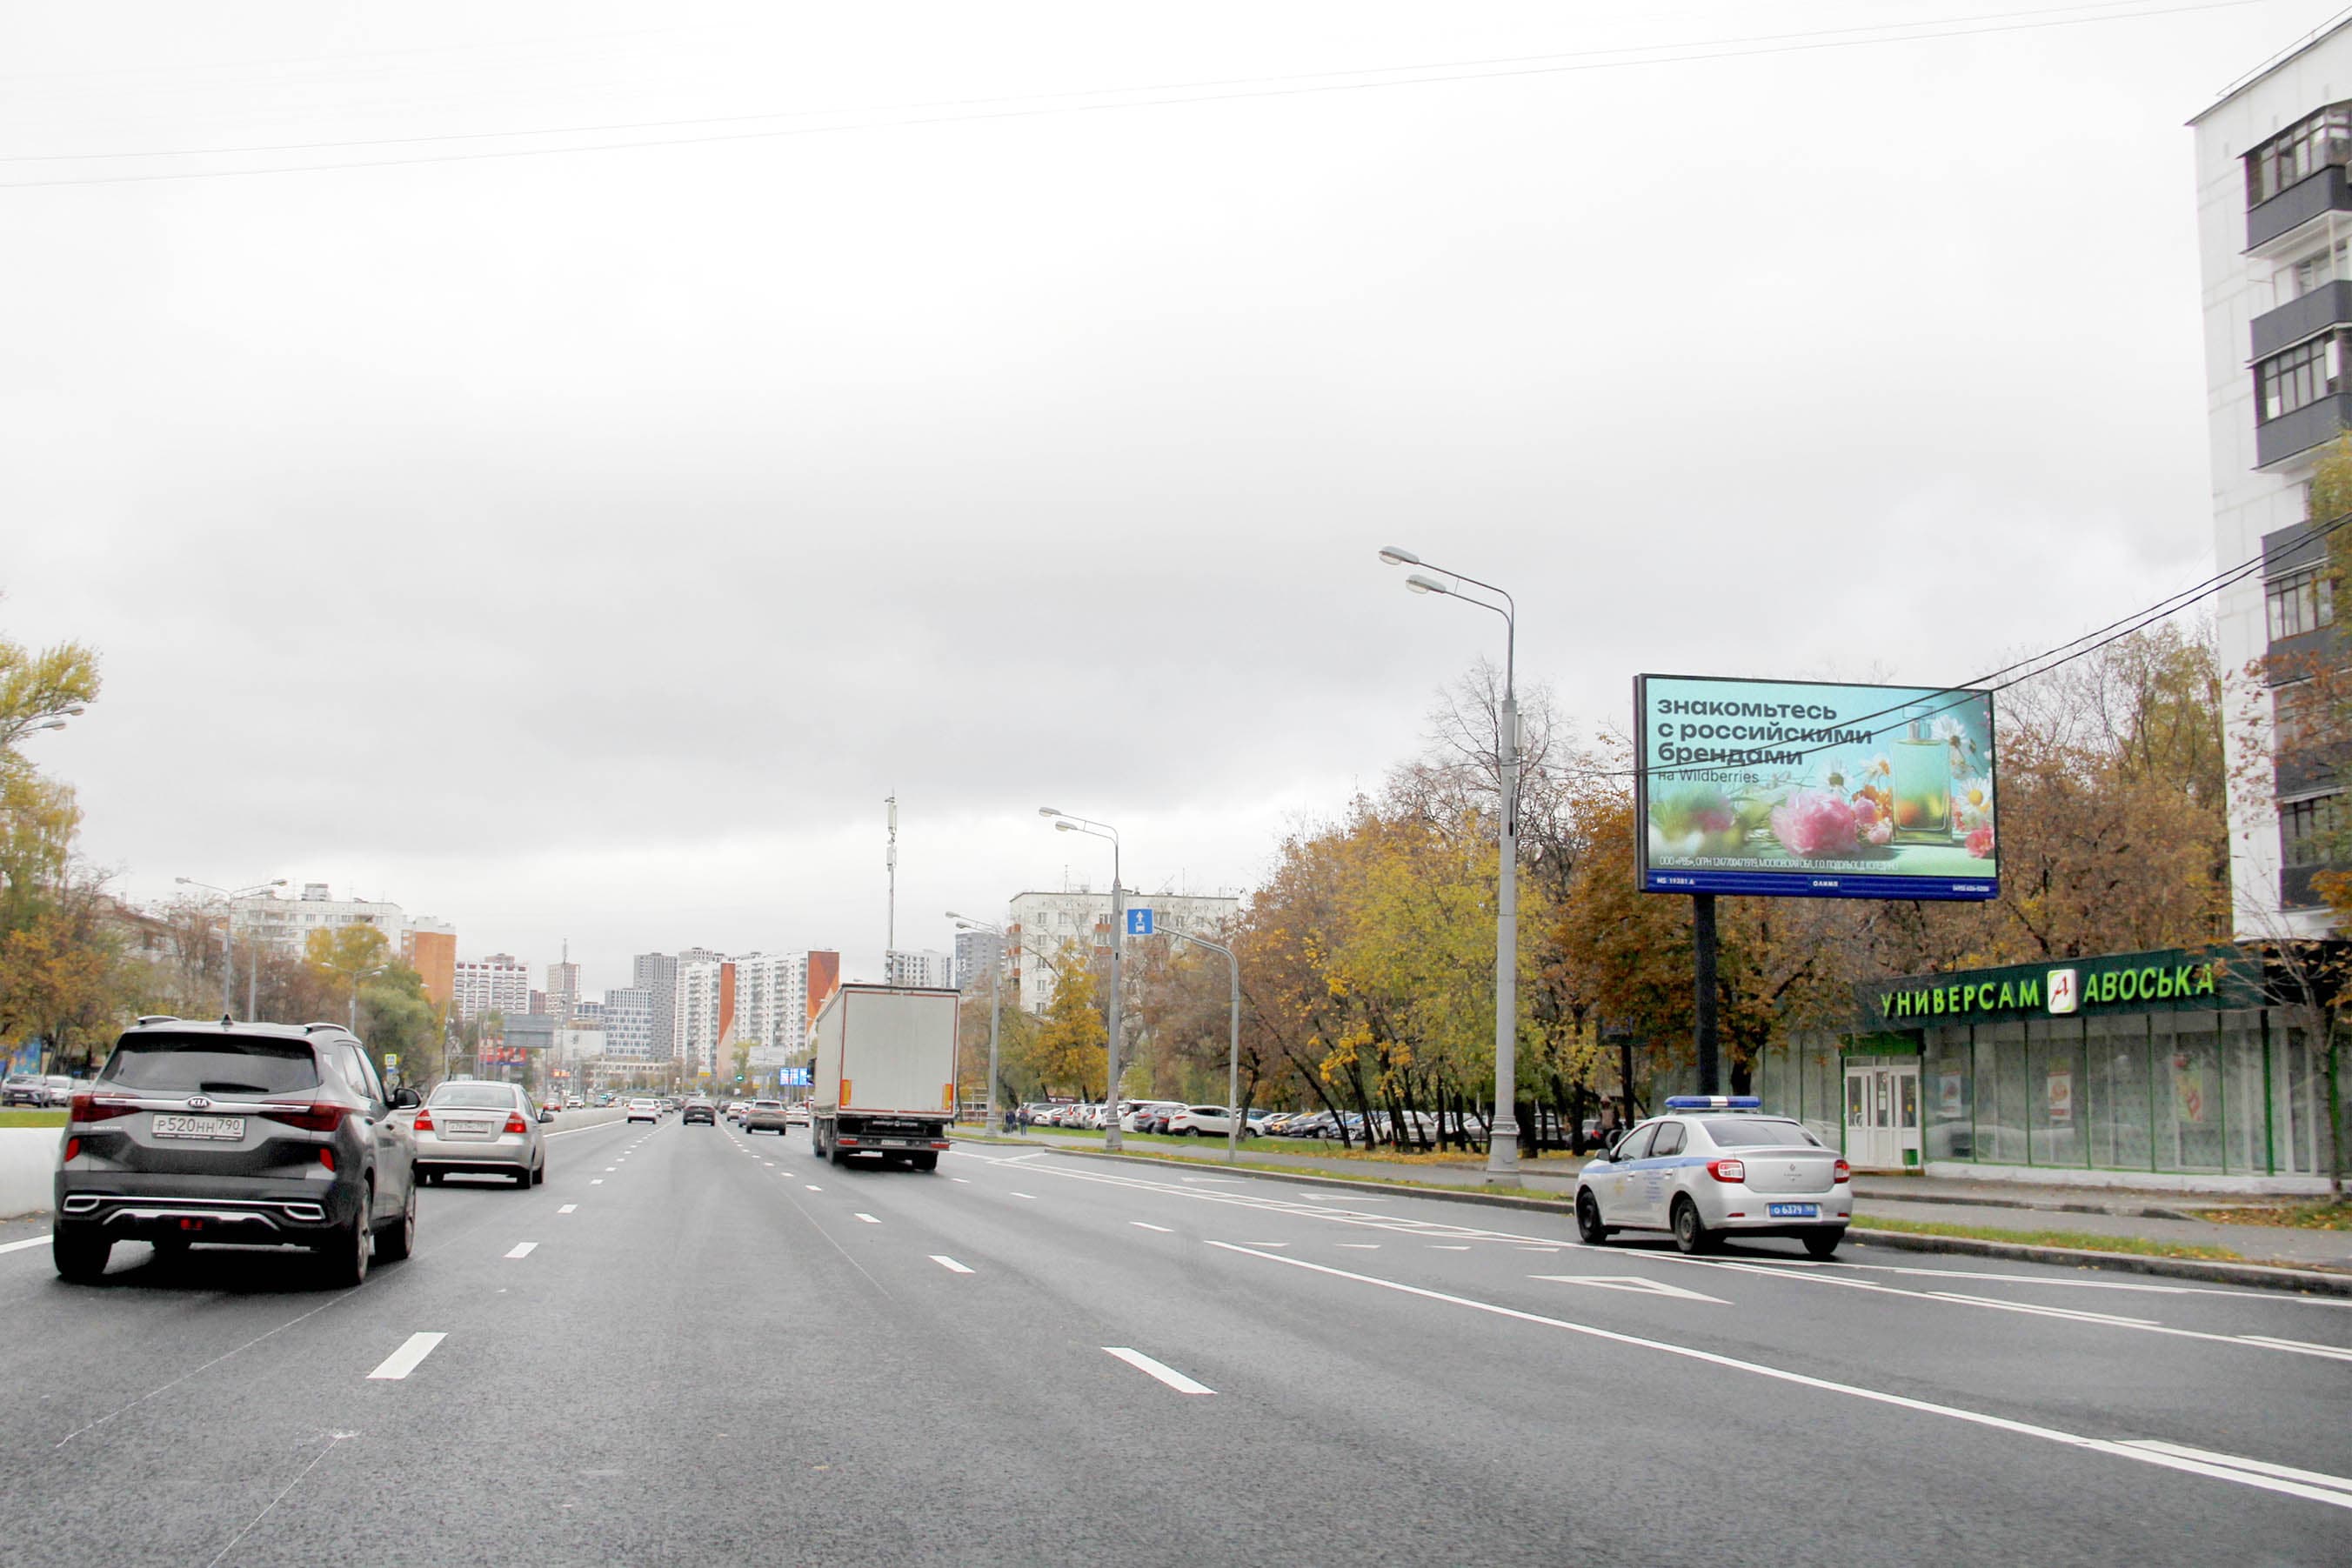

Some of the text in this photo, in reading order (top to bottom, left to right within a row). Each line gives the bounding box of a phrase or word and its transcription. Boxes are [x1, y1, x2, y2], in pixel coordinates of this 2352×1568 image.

[1657, 699, 1837, 720] знакомьтесь
[1657, 722, 1872, 744] с российскими
[1658, 742, 1803, 766] брендами
[1658, 769, 1760, 784] на Wildberries
[1880, 978, 2041, 1018] УНИВЕРСАМ
[2083, 963, 2215, 1003] АВОСЬКА
[190, 1098, 209, 1107] KIA
